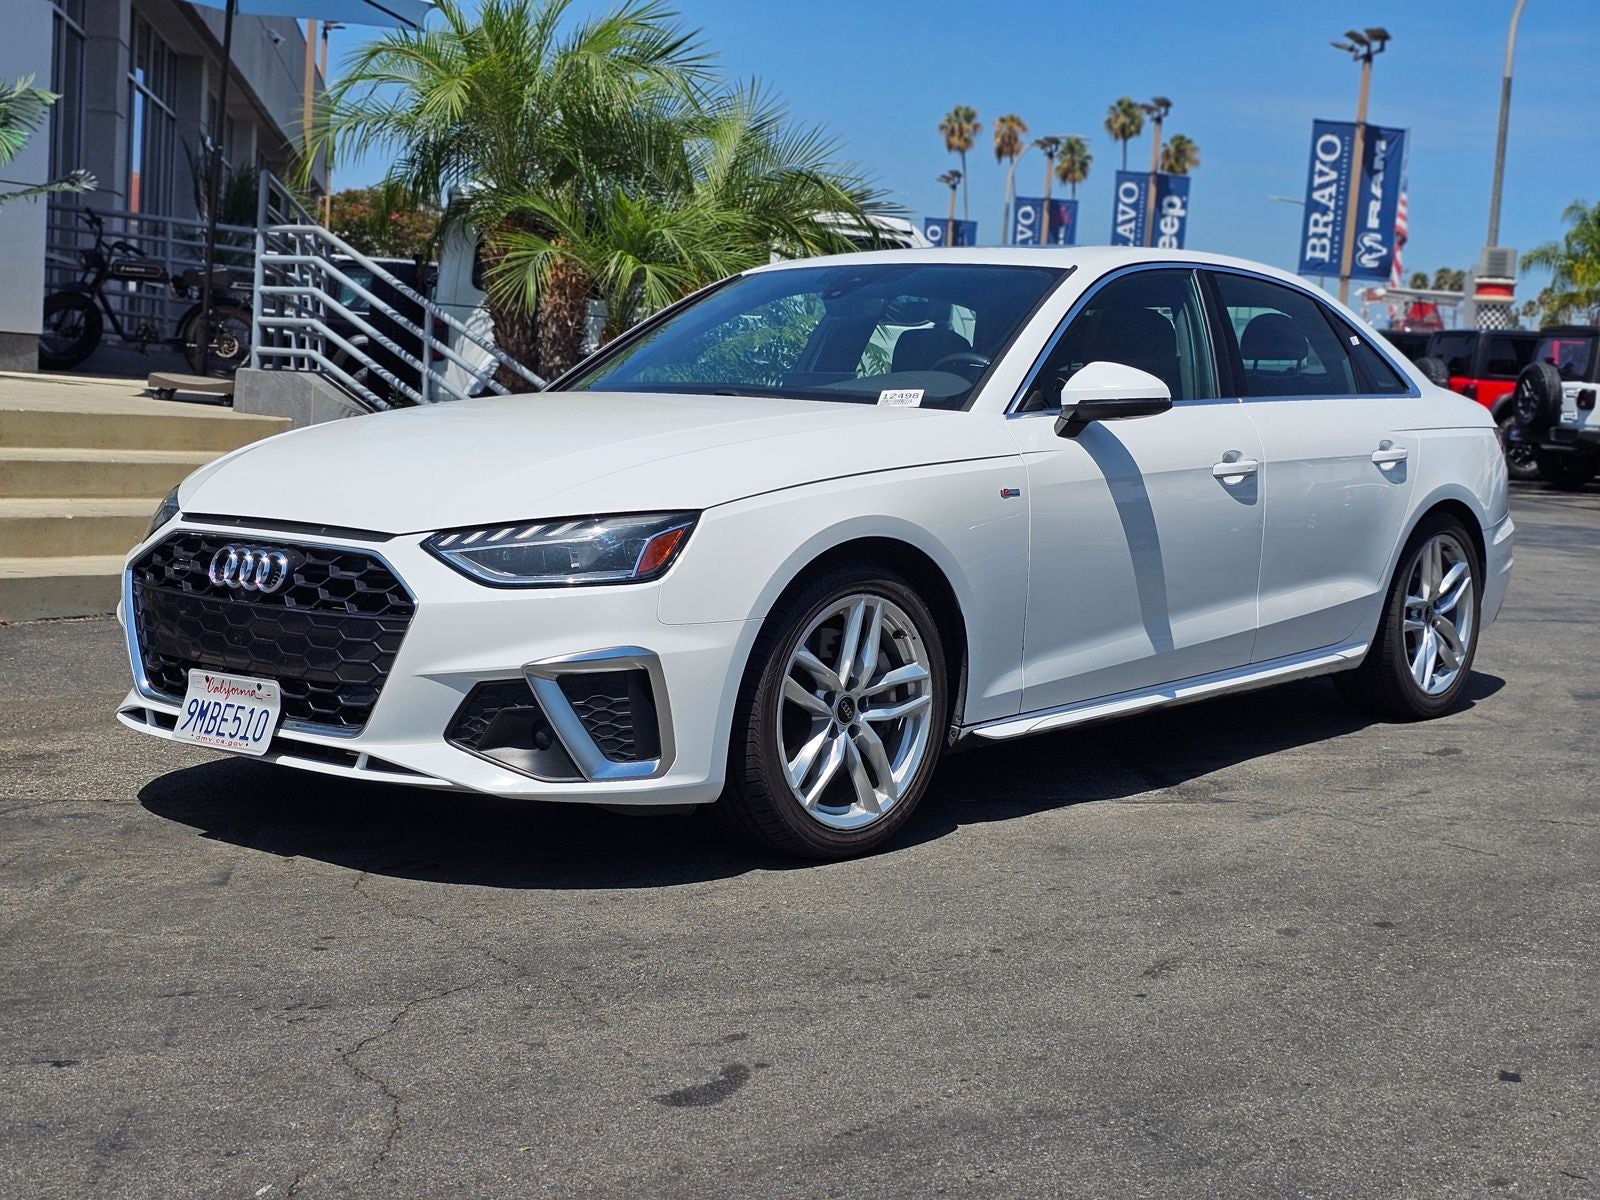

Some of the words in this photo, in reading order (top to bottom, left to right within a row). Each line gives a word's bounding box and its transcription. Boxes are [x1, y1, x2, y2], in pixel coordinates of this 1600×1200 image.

[1305, 134, 1342, 263] BRAVO
[1366, 140, 1387, 229] RAM
[1116, 182, 1139, 247] AVO
[883, 392, 919, 400] 12498
[207, 677, 262, 700] California
[181, 698, 270, 742] 9MBE510
[195, 735, 244, 747] dmv.ca.gov
